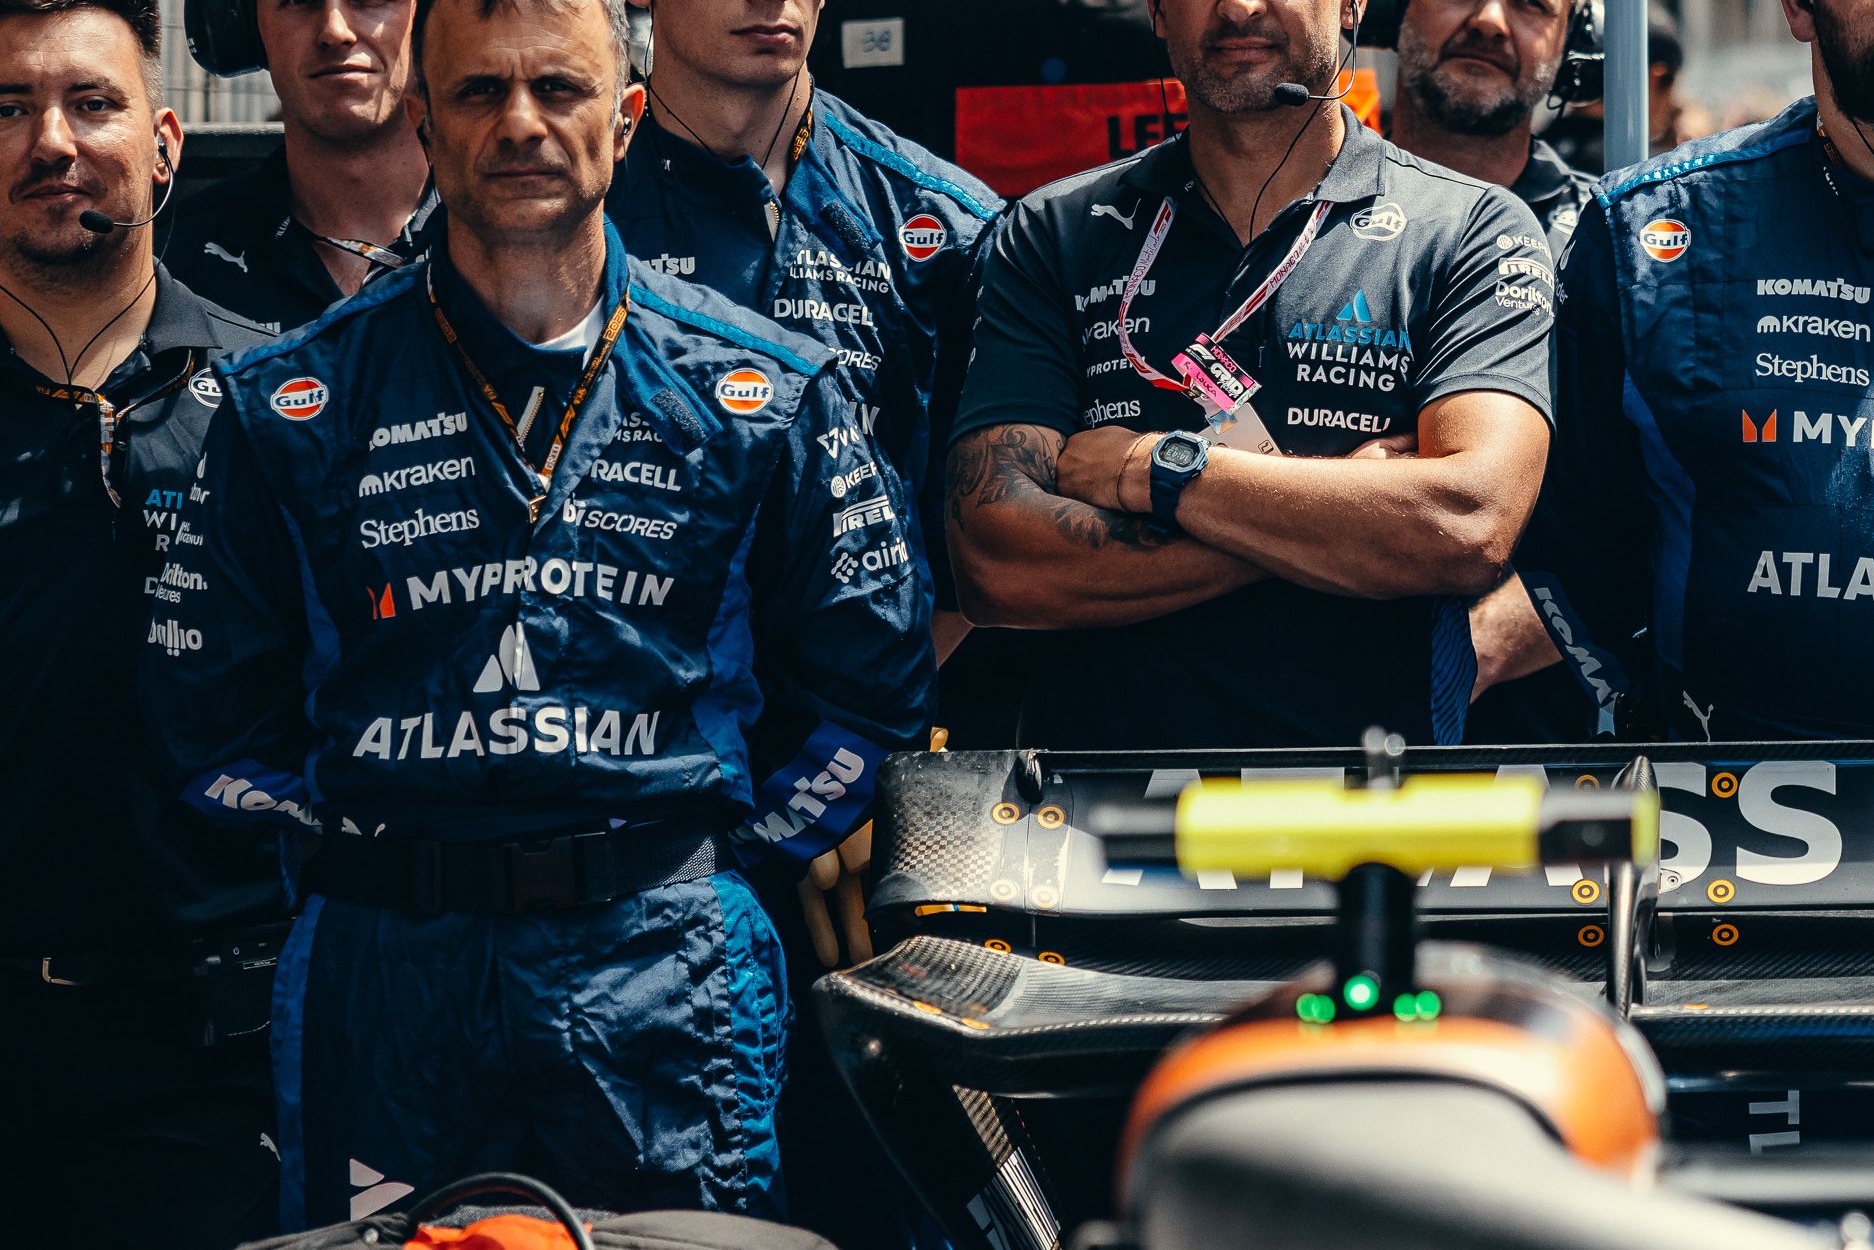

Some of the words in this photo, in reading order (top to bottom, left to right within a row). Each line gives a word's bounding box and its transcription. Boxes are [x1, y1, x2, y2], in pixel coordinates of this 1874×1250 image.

[903, 230, 945, 246] Gulf
[1643, 233, 1688, 247] Gulf
[1757, 278, 1871, 304] KOMATSU
[1288, 323, 1412, 350] ATLASSIAN
[1210, 345, 1237, 373] MONACO
[1287, 342, 1410, 374] WILLIAMS
[1755, 353, 1870, 387] Stephens
[720, 383, 770, 398] Gulf
[1210, 362, 1244, 395] GRID
[1296, 364, 1396, 392] RACING
[275, 390, 324, 407] Gulf
[359, 508, 480, 550] Stephens
[406, 556, 674, 610] MYPROTEIN
[352, 706, 660, 760] ATLASSIAN
